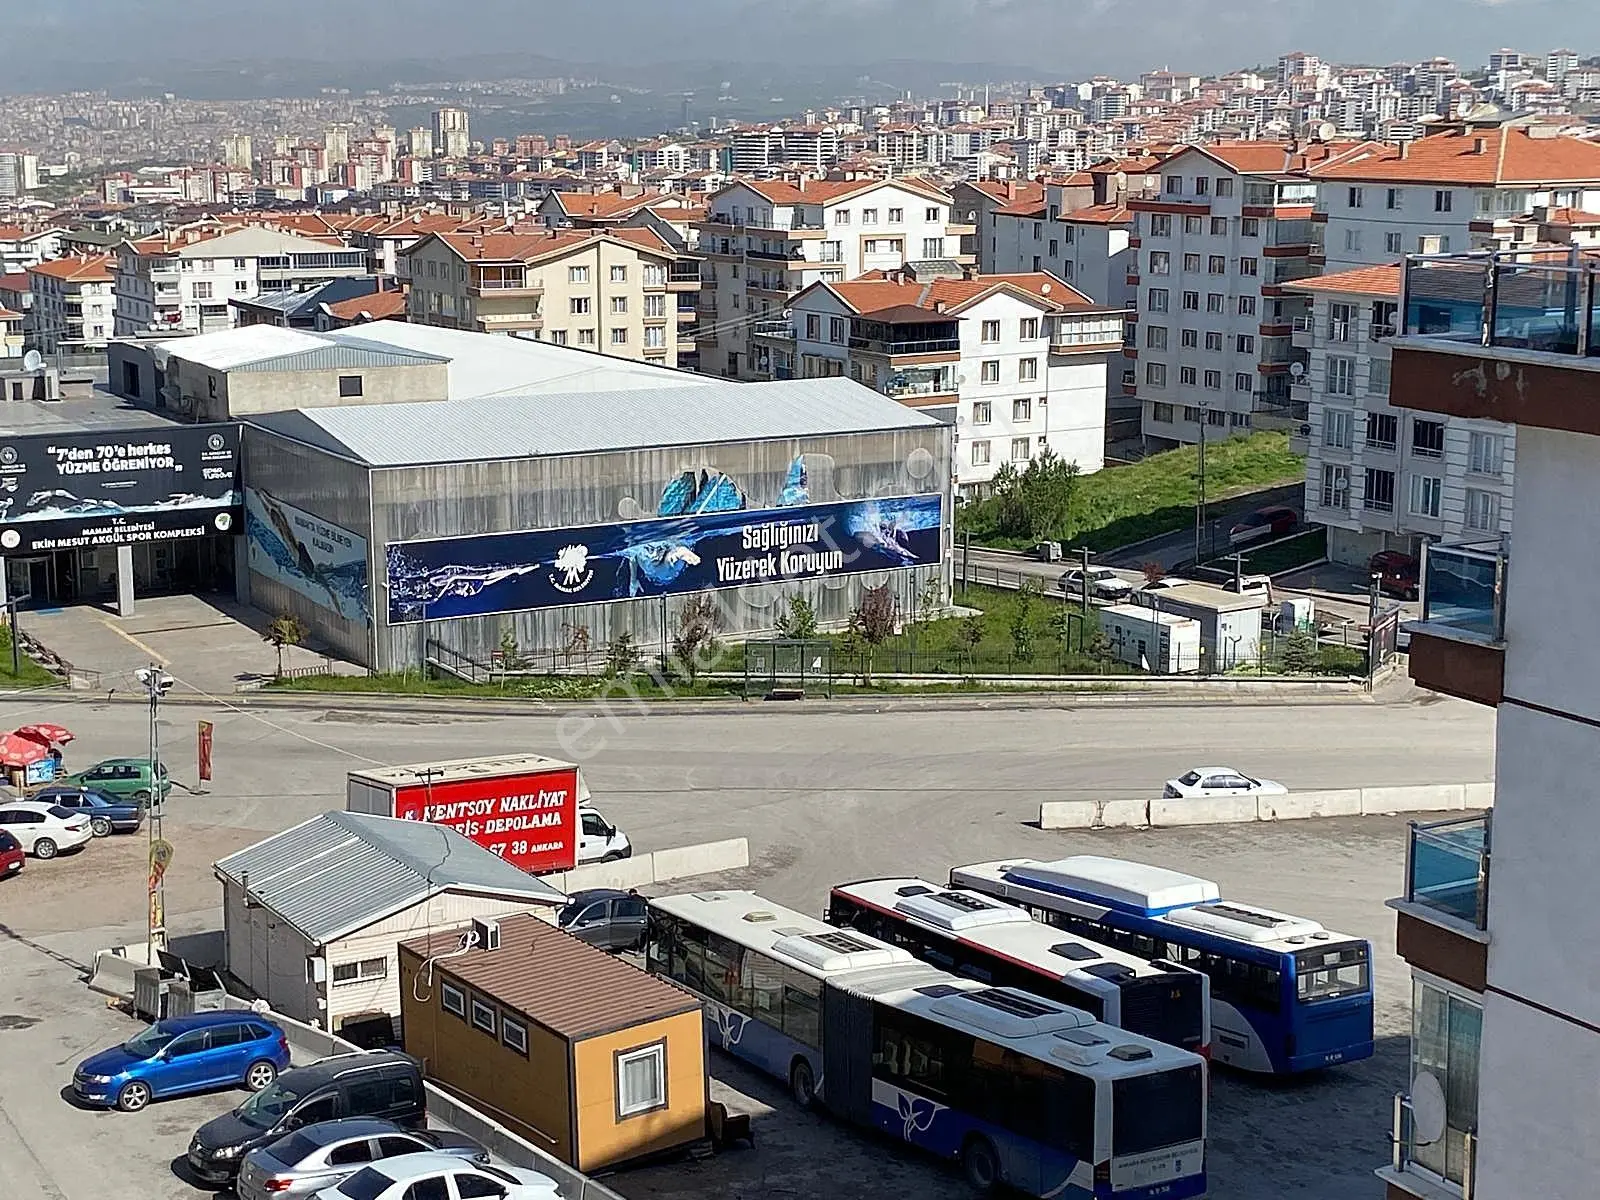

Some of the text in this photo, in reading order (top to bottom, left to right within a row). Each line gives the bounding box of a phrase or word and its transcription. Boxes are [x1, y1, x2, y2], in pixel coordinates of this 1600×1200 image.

[127, 442, 171, 456] herkes
[56, 461, 101, 475] YÜZME
[31, 525, 205, 550] EKİN MESUT AKGÜL SPOR KOMPLEKSİ
[82, 521, 155, 536] MAMAK BELEDİYESİ
[742, 520, 819, 551] Sağlığınızı
[716, 550, 843, 582] Yüzerek Koruyun
[499, 789, 568, 812] NAKLİYAT
[511, 840, 528, 855] 38
[531, 841, 564, 854] ANKARA
